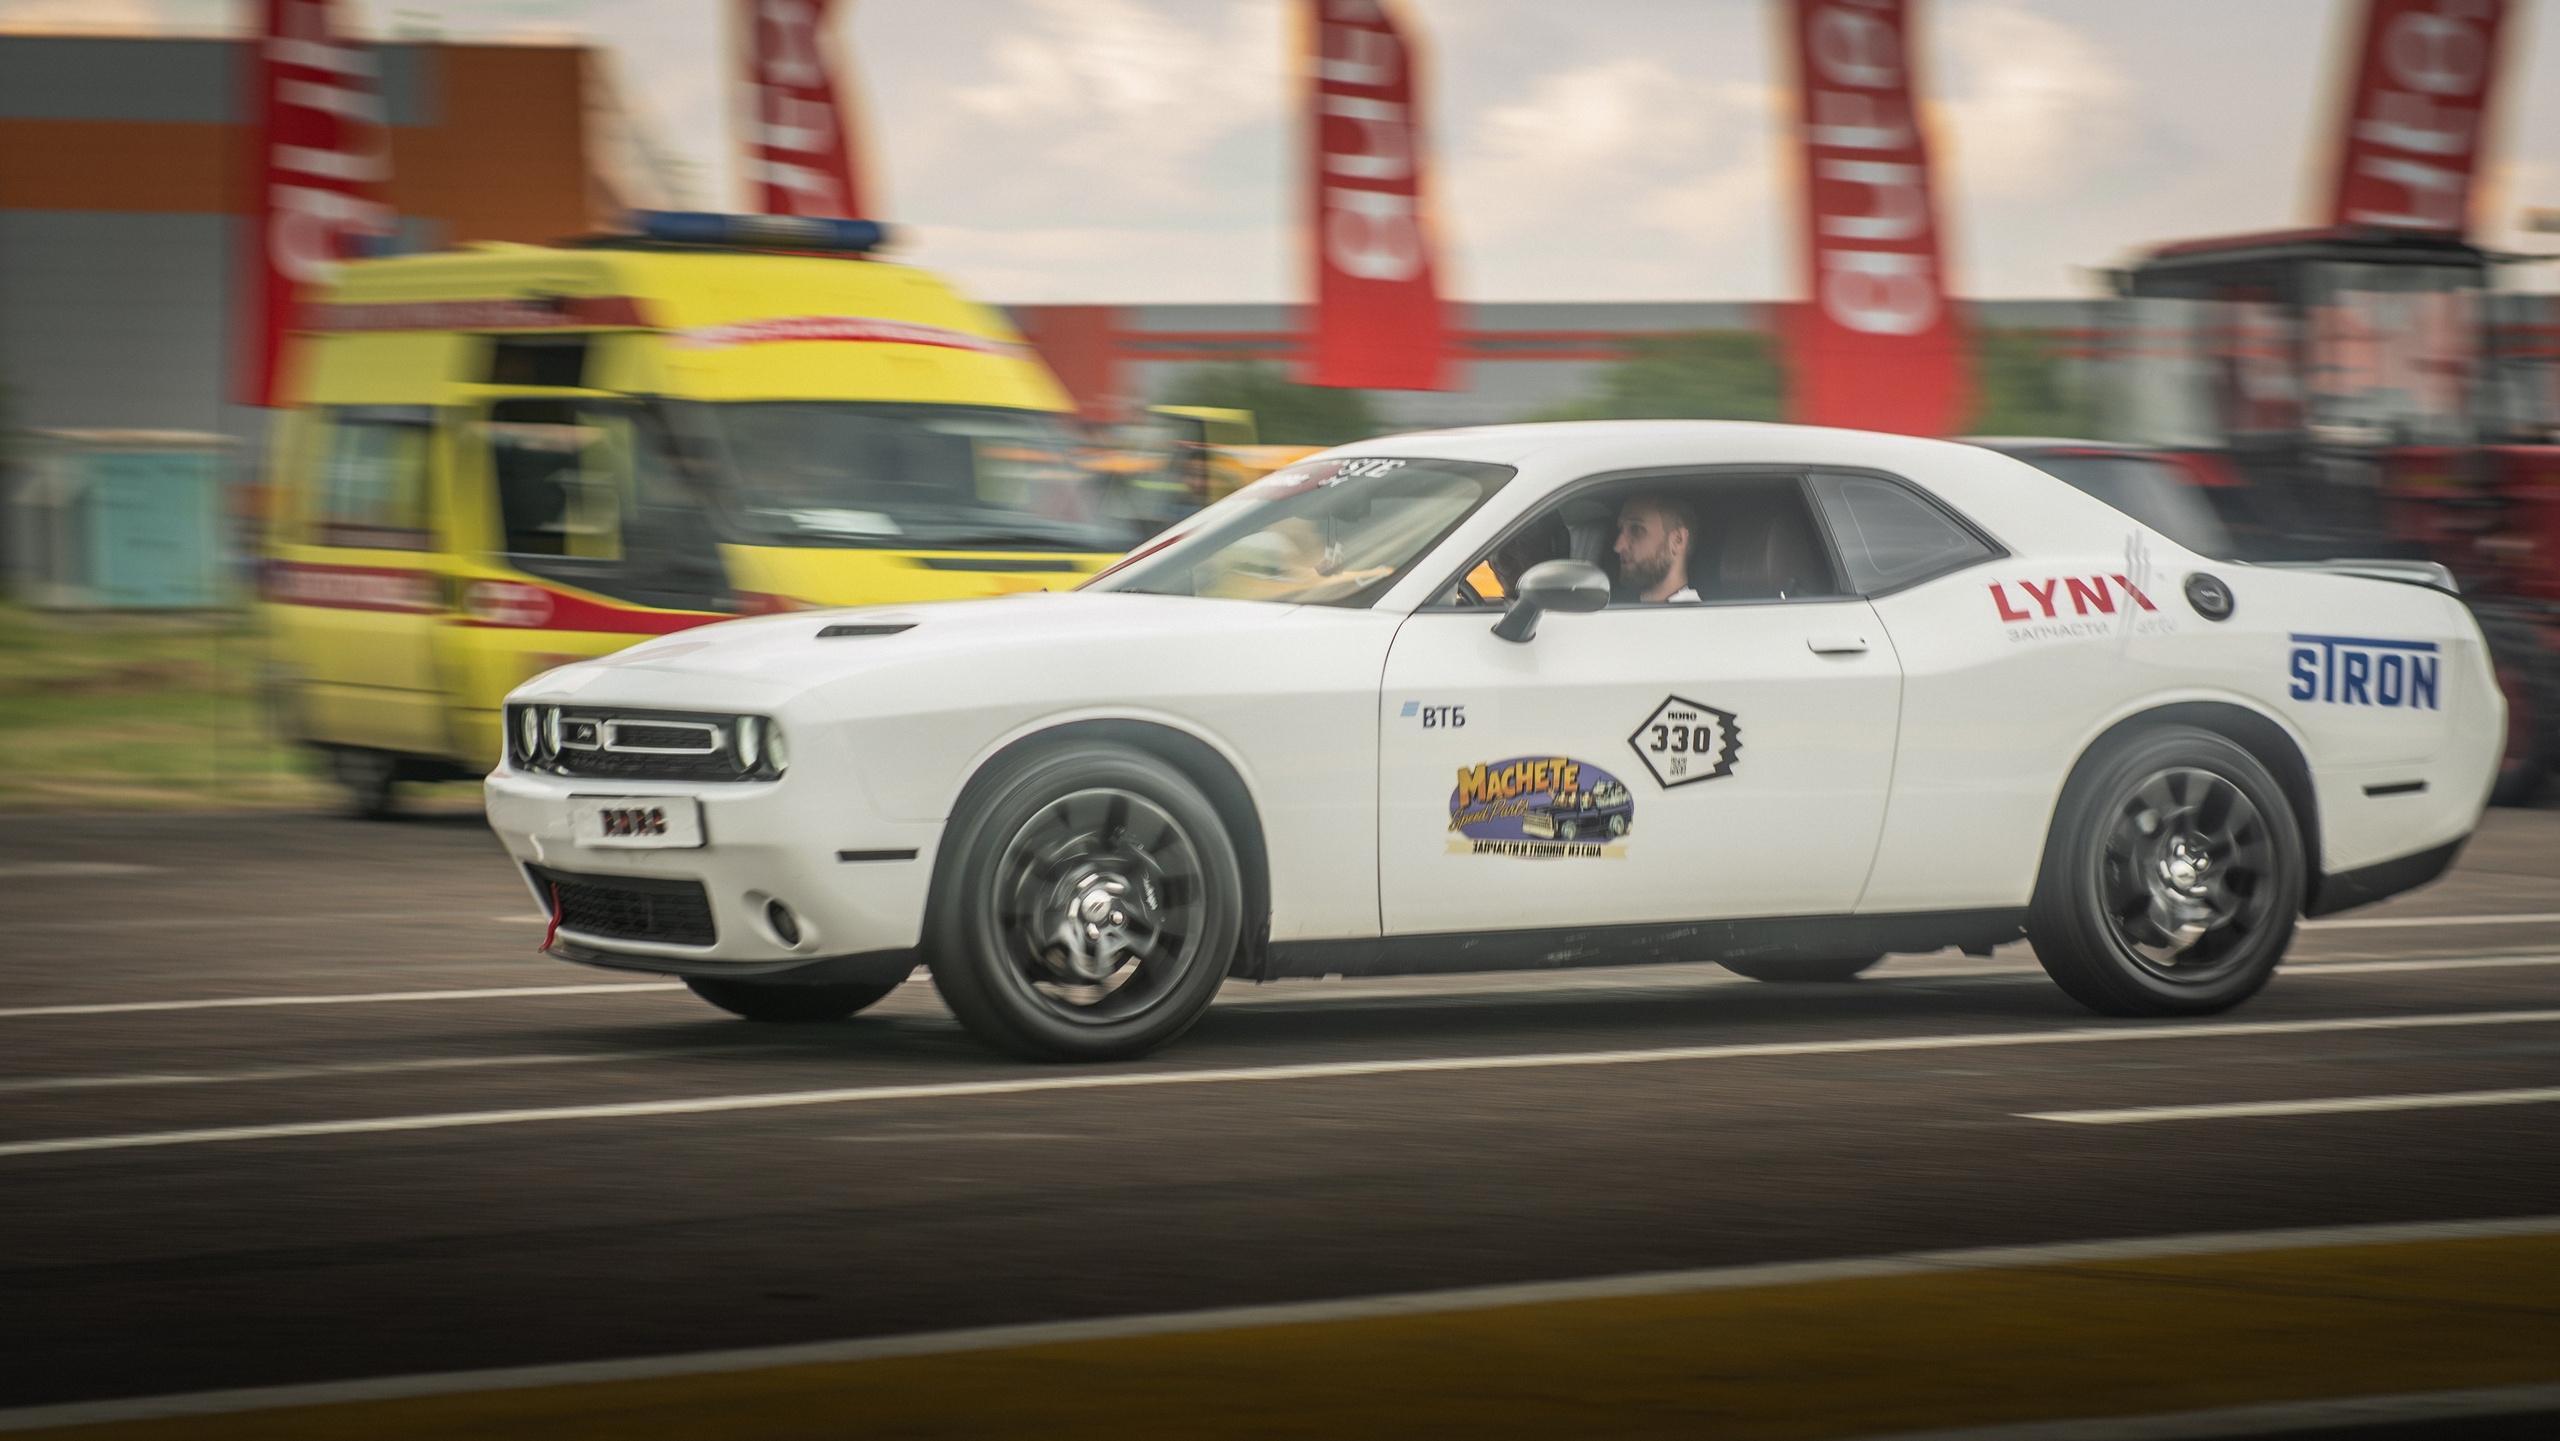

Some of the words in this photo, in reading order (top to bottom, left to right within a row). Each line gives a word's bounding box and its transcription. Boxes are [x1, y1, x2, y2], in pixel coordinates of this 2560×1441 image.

[1988, 574, 2160, 623] LYNX
[2006, 622, 2110, 643] ЗАПЧАСТИ
[2290, 632, 2442, 711] STRON
[1422, 705, 1466, 728] ВТБ
[1650, 724, 1711, 754] 330
[1447, 803, 1490, 833] Speed
[1488, 797, 1530, 824] Parts
[1472, 840, 1519, 855] ЗАПЧАСТИ
[1529, 841, 1566, 857] ТЮНИНГ
[1567, 842, 1580, 857] ИЗ
[1581, 843, 1602, 858] США
